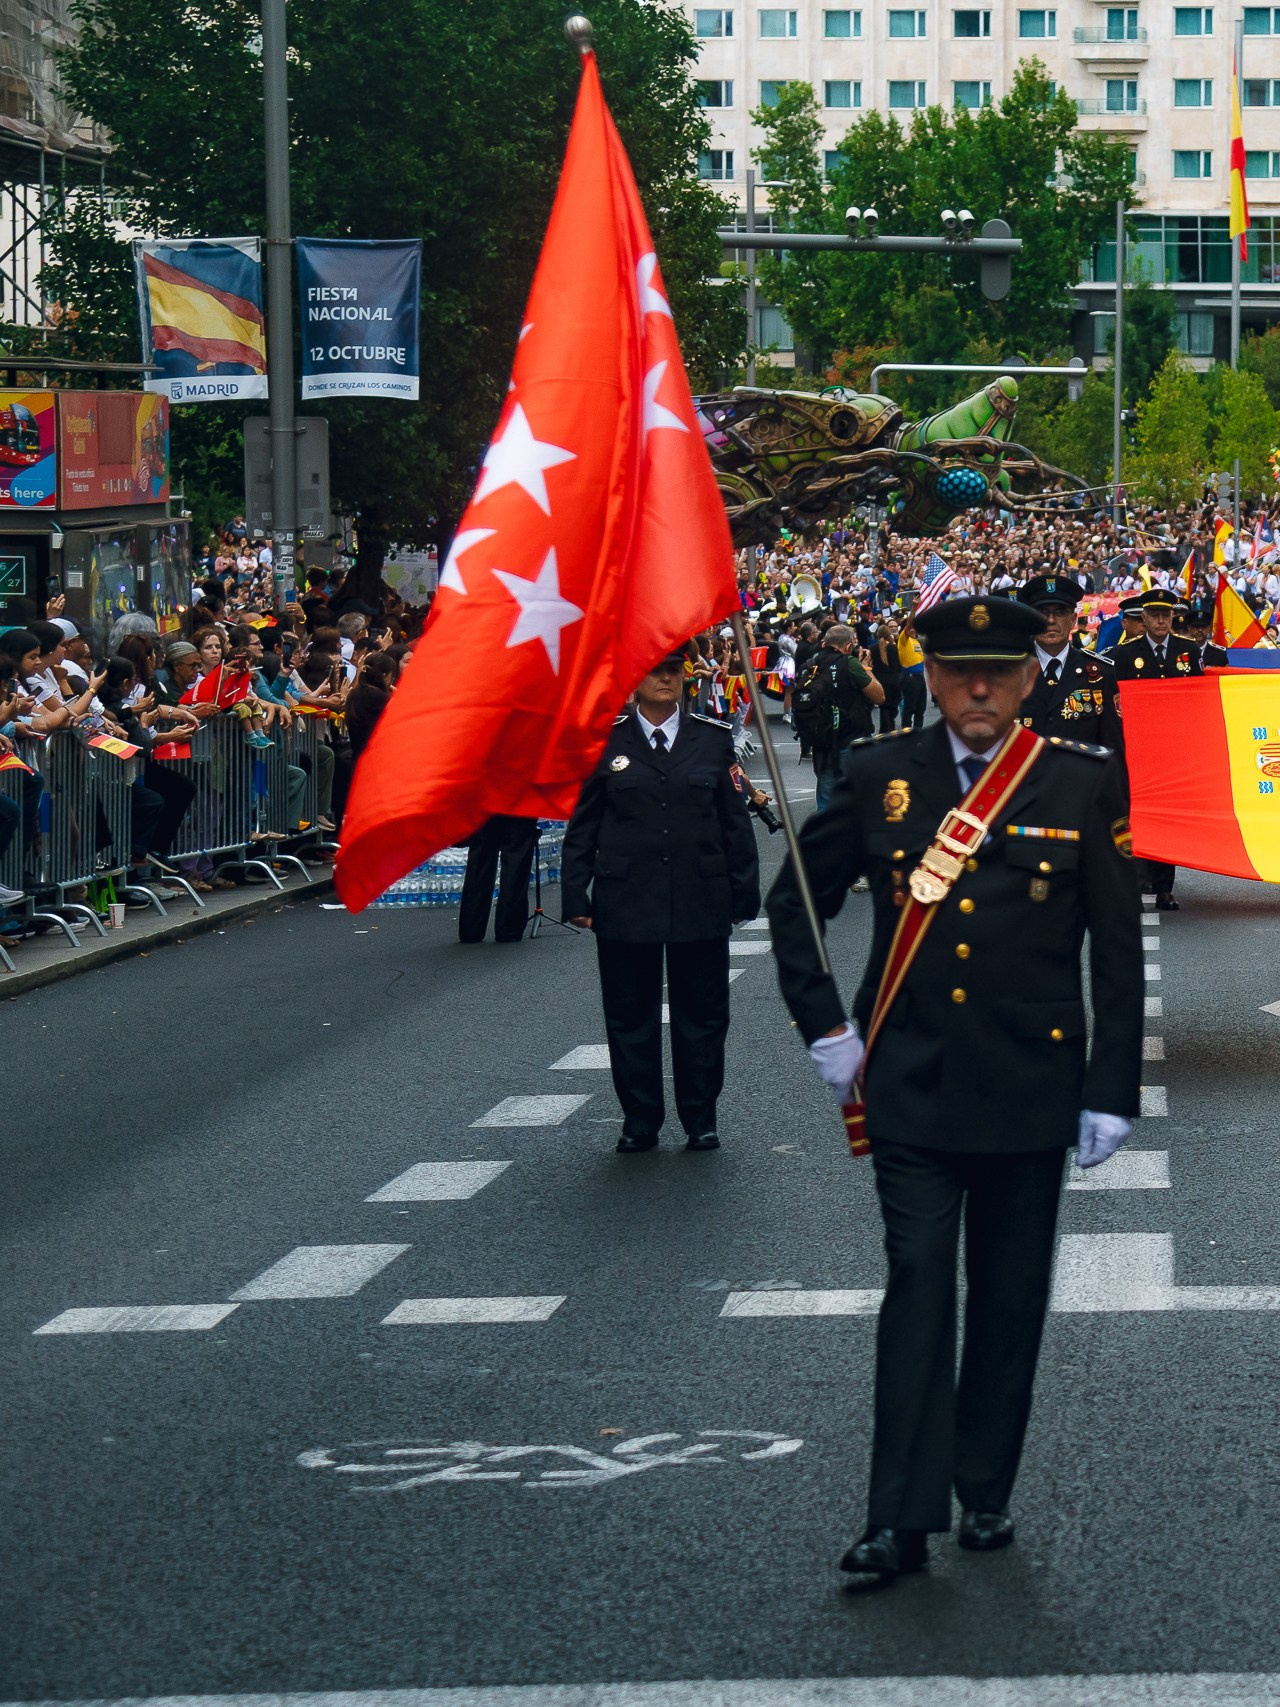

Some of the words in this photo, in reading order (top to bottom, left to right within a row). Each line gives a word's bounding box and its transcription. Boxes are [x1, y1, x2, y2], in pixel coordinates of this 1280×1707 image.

[308, 287, 358, 302] FIESTA
[308, 306, 393, 321] NACIONAL
[310, 347, 324, 361] 12
[328, 345, 406, 365] OCTUBRE
[186, 383, 239, 397] MADRID
[308, 383, 328, 391] DONDE
[338, 382, 366, 390] CRUZAN
[381, 382, 412, 391] CAMINOS
[14, 486, 44, 498] here
[7, 578, 21, 587] 27
